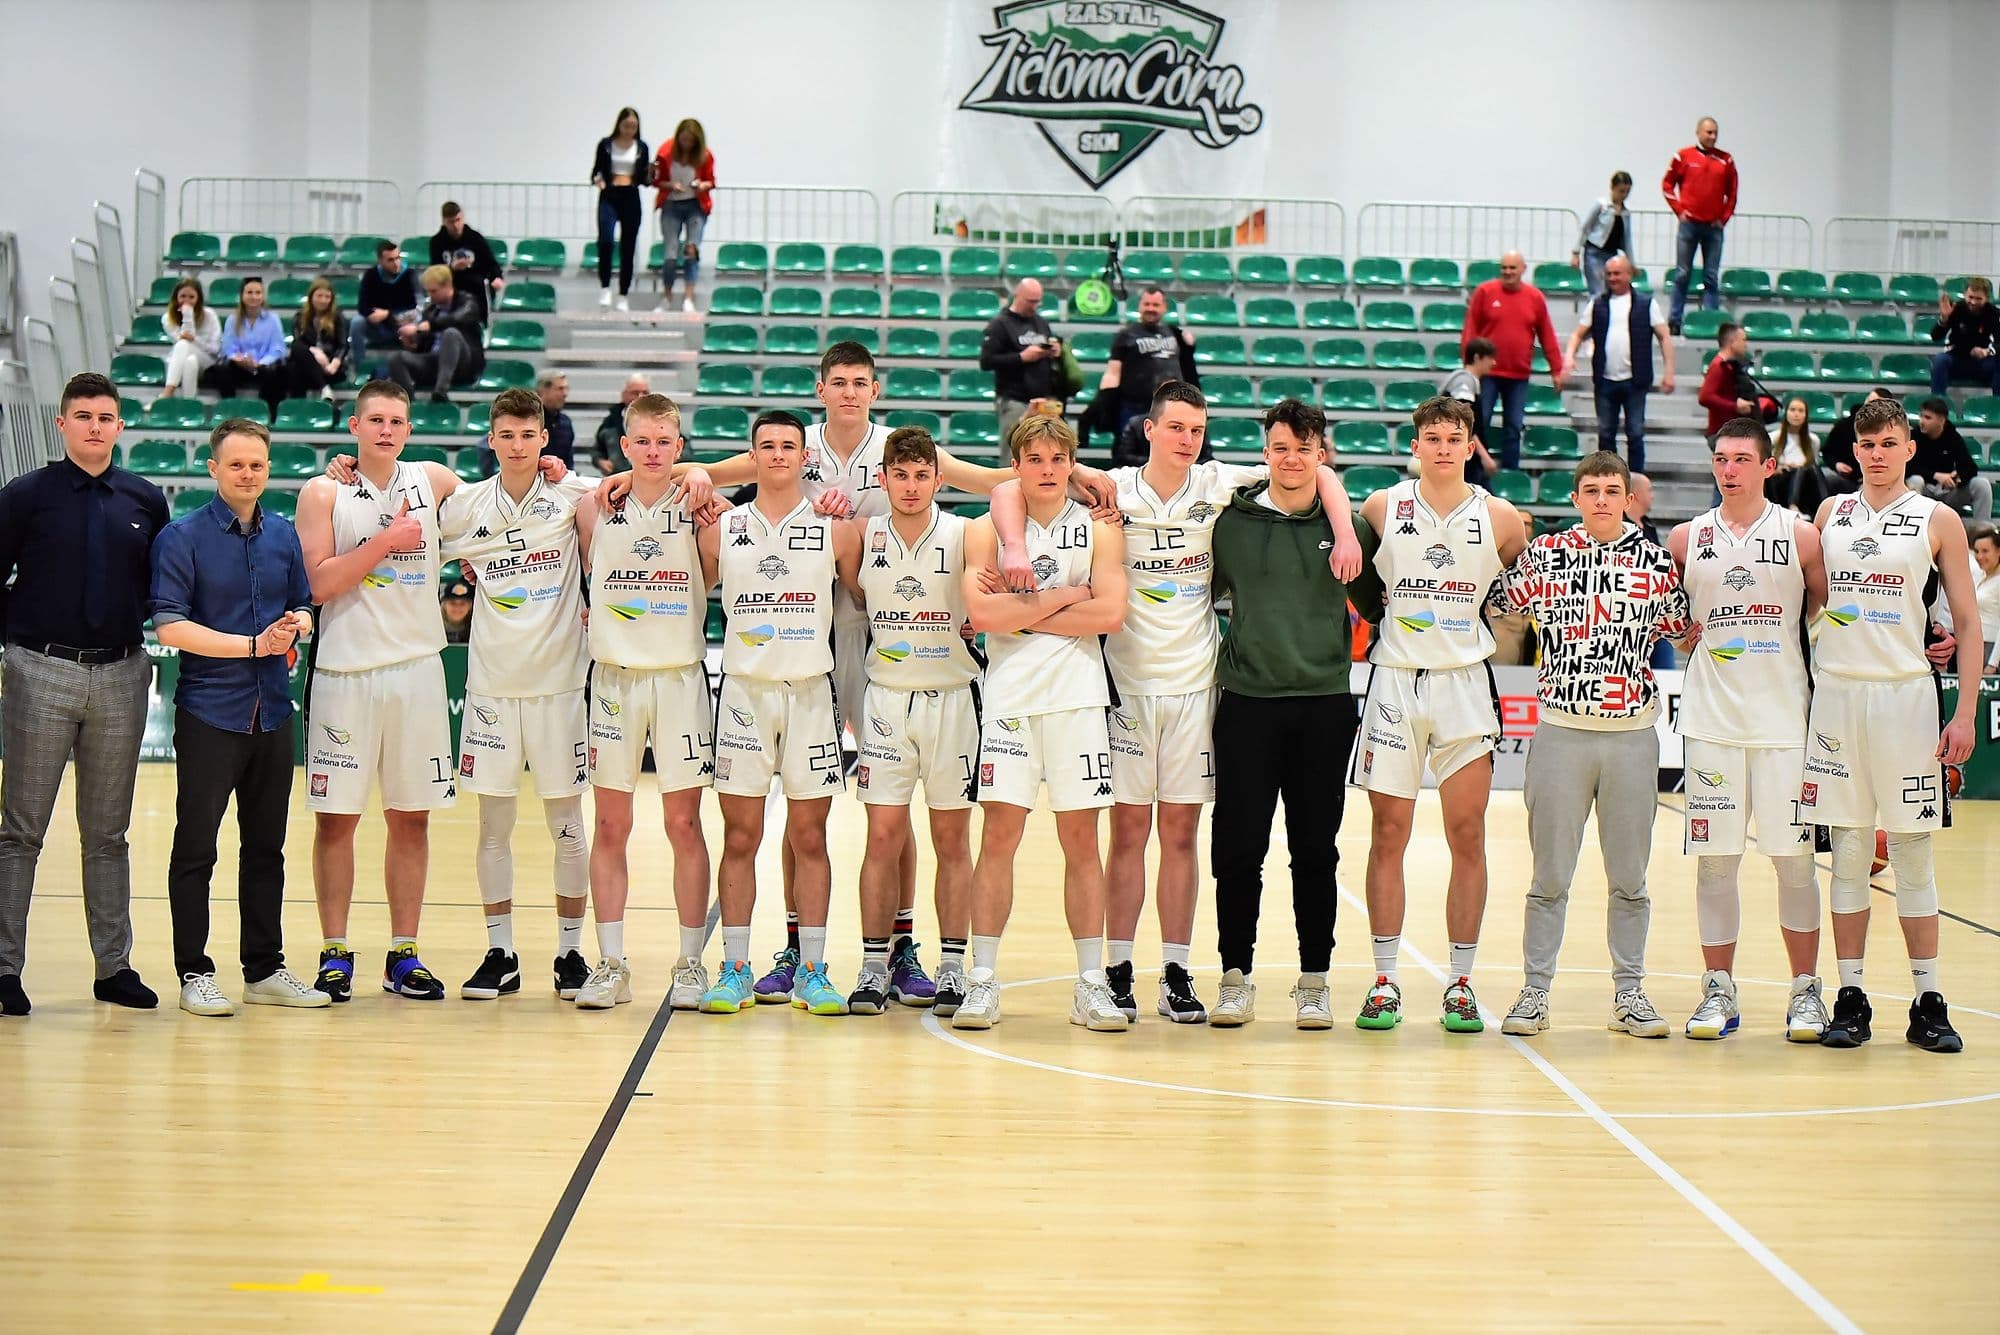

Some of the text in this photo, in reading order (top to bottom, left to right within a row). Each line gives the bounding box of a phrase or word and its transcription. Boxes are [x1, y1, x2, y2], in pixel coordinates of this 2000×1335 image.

[1064, 3, 1160, 26] ZASTAL
[959, 28, 1129, 109] Zielona
[1079, 132, 1120, 153] SKM
[661, 510, 695, 535] 14
[1467, 518, 1481, 544] 3
[1882, 512, 1924, 537] 25
[506, 528, 527, 552] 5
[788, 526, 824, 550] 23
[1057, 524, 1087, 549] 18
[1150, 528, 1185, 551] 12
[934, 547, 950, 574] 1
[1755, 538, 1789, 566] 10
[645, 585, 688, 593] MEDYCZNE
[1393, 592, 1429, 600] CENTRUM
[1859, 587, 1902, 597] MEDYCZNE
[650, 601, 688, 611] Lubuskie
[733, 608, 768, 616] CENTRUM
[1863, 608, 1901, 620] Lubuskie
[778, 627, 815, 636] Lubuskie
[488, 740, 506, 750] Góra
[720, 738, 762, 752] Zielona Góra
[1009, 747, 1029, 758] Góra
[1126, 746, 1144, 757] Góra
[1389, 740, 1407, 751] Góra
[312, 755, 359, 769] Zielona Góra
[574, 741, 586, 769] 5
[808, 741, 840, 771] 23
[883, 752, 902, 762] Góra
[1080, 752, 1111, 781] 18
[1805, 762, 1849, 779] Zielona Góra
[1902, 774, 1936, 804] 25
[1688, 801, 1736, 810] Zielona Góra
